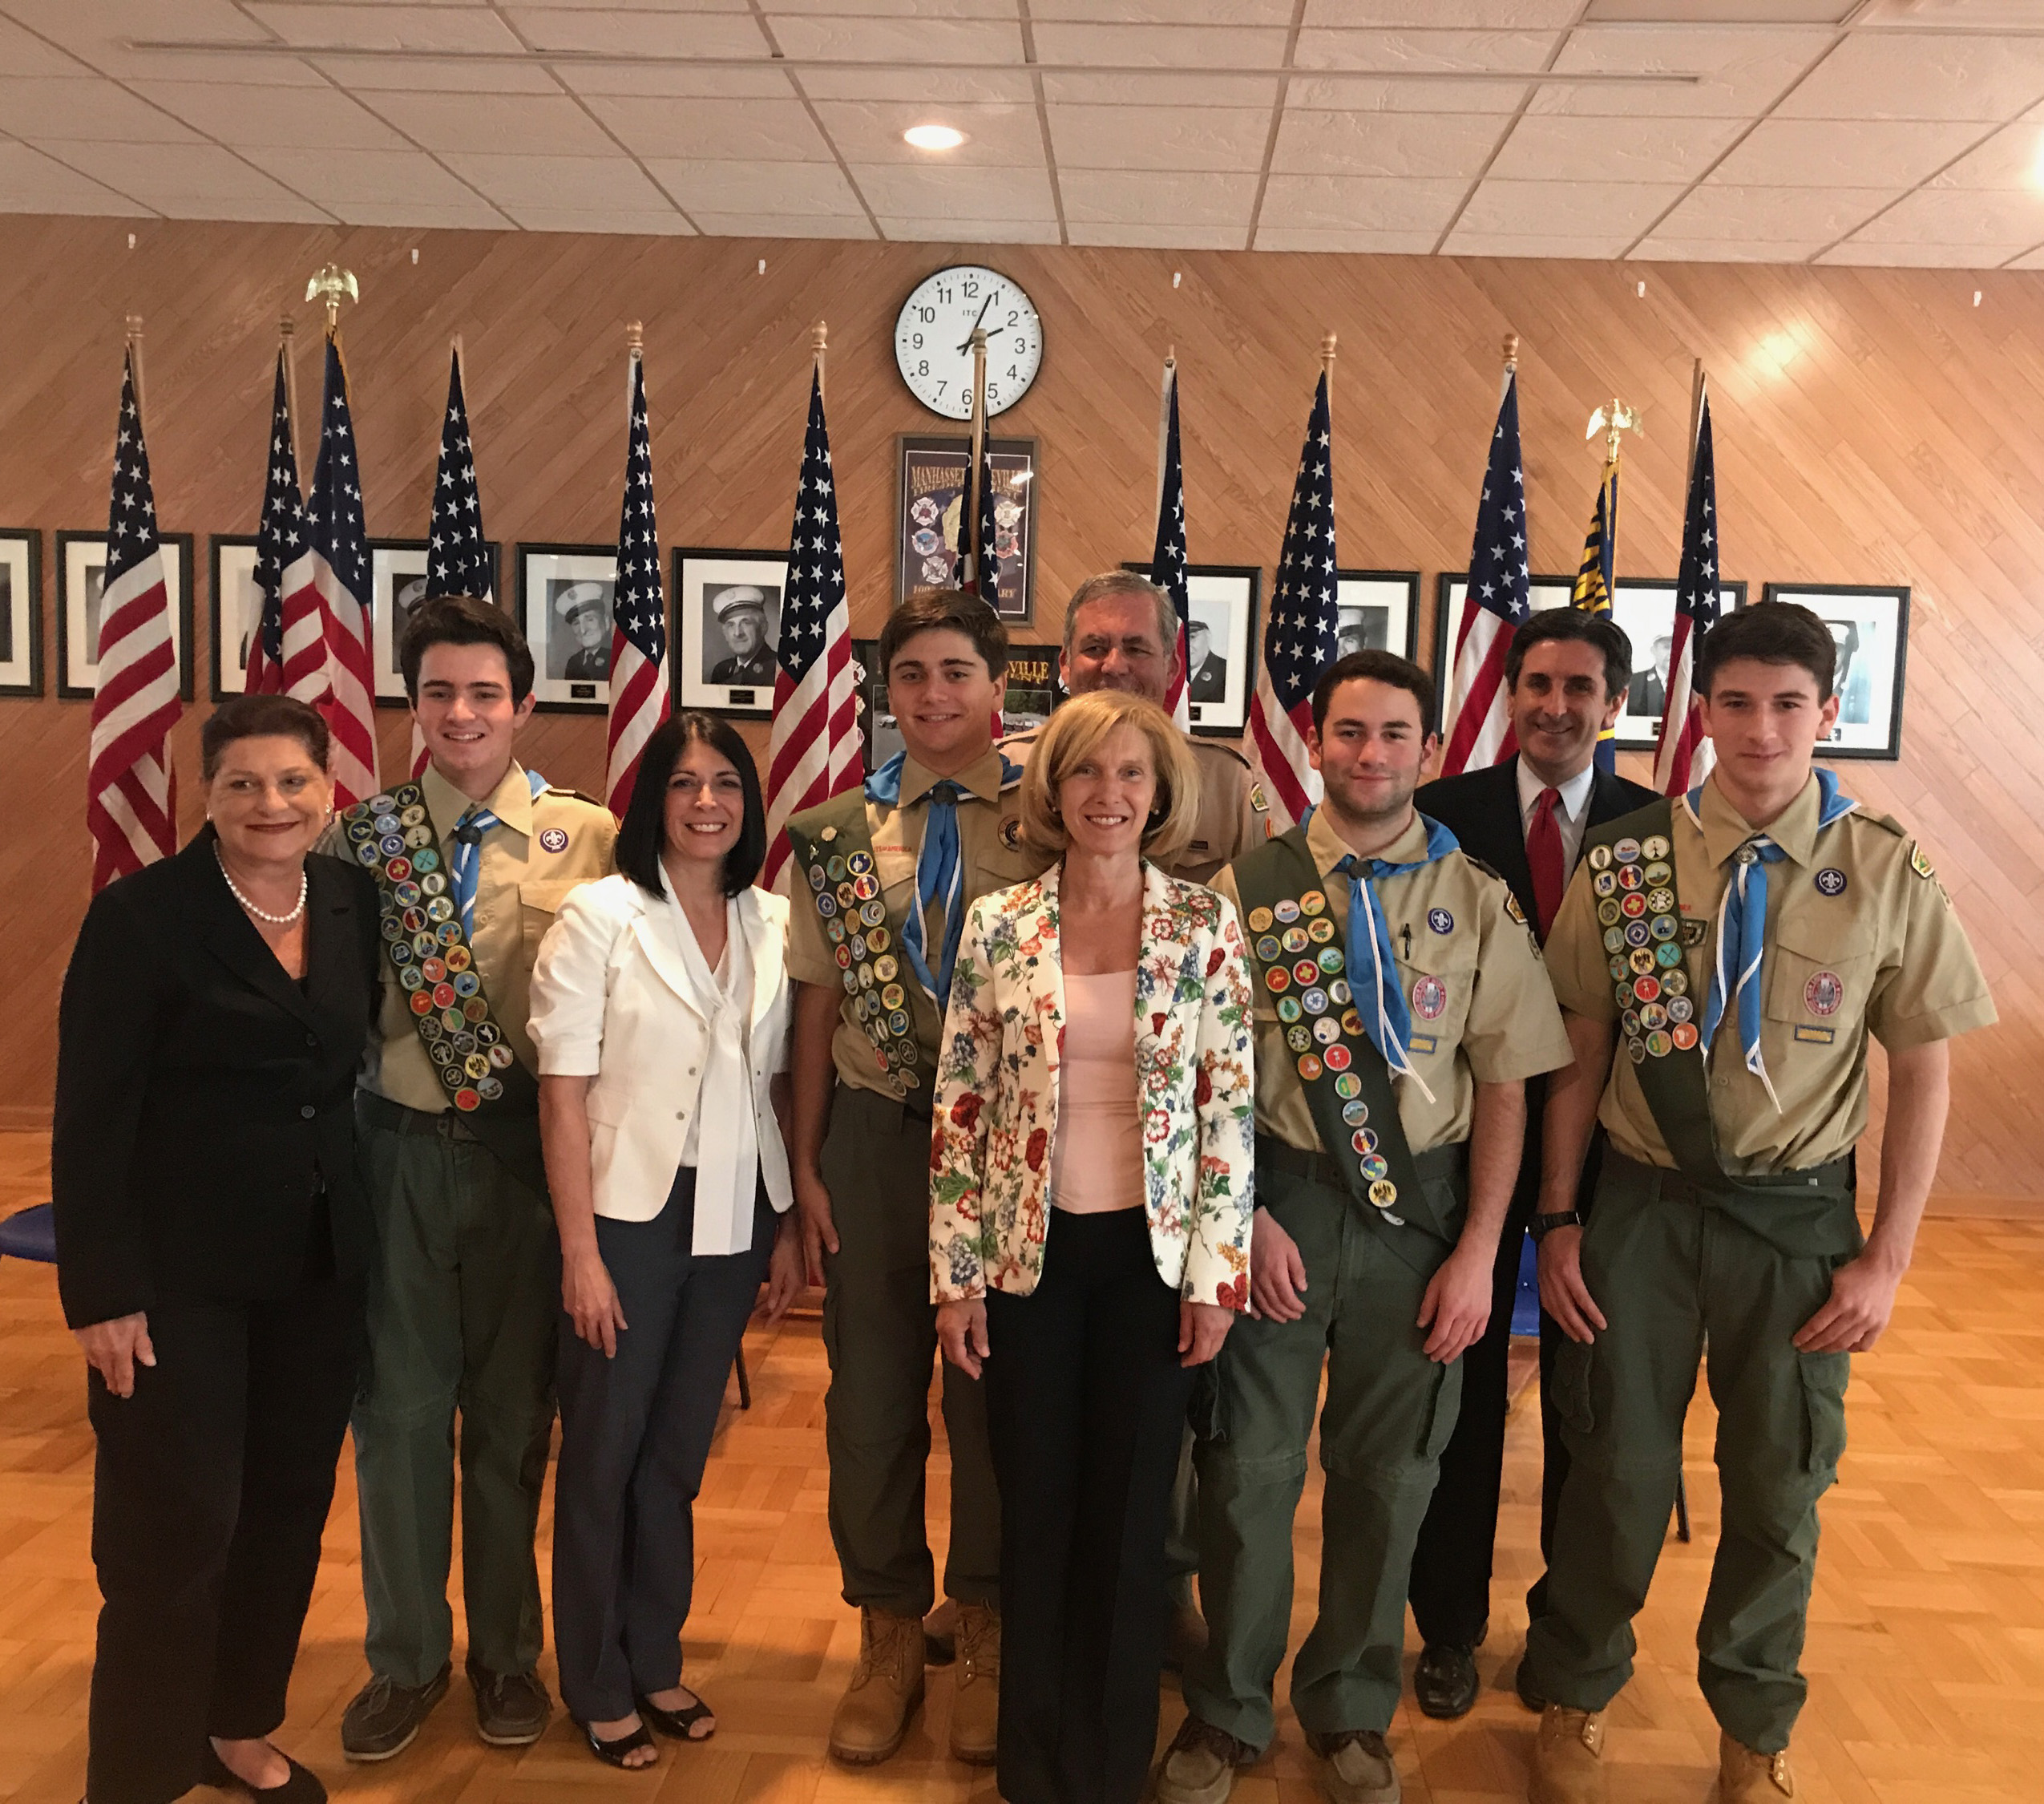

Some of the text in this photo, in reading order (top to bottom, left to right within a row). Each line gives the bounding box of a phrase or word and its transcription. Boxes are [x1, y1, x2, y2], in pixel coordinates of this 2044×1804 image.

[937, 288, 951, 304] 11
[961, 281, 979, 298] 12
[992, 290, 1000, 306] 1
[918, 306, 935, 323] 10
[962, 309, 978, 318] ITC
[1007, 310, 1019, 327] 2
[912, 333, 923, 350] 9
[1014, 338, 1025, 354] 3
[918, 360, 929, 377] 8
[1006, 364, 1017, 380] 4
[936, 380, 947, 396] 7
[987, 382, 998, 399] 5
[961, 389, 973, 406] 6
